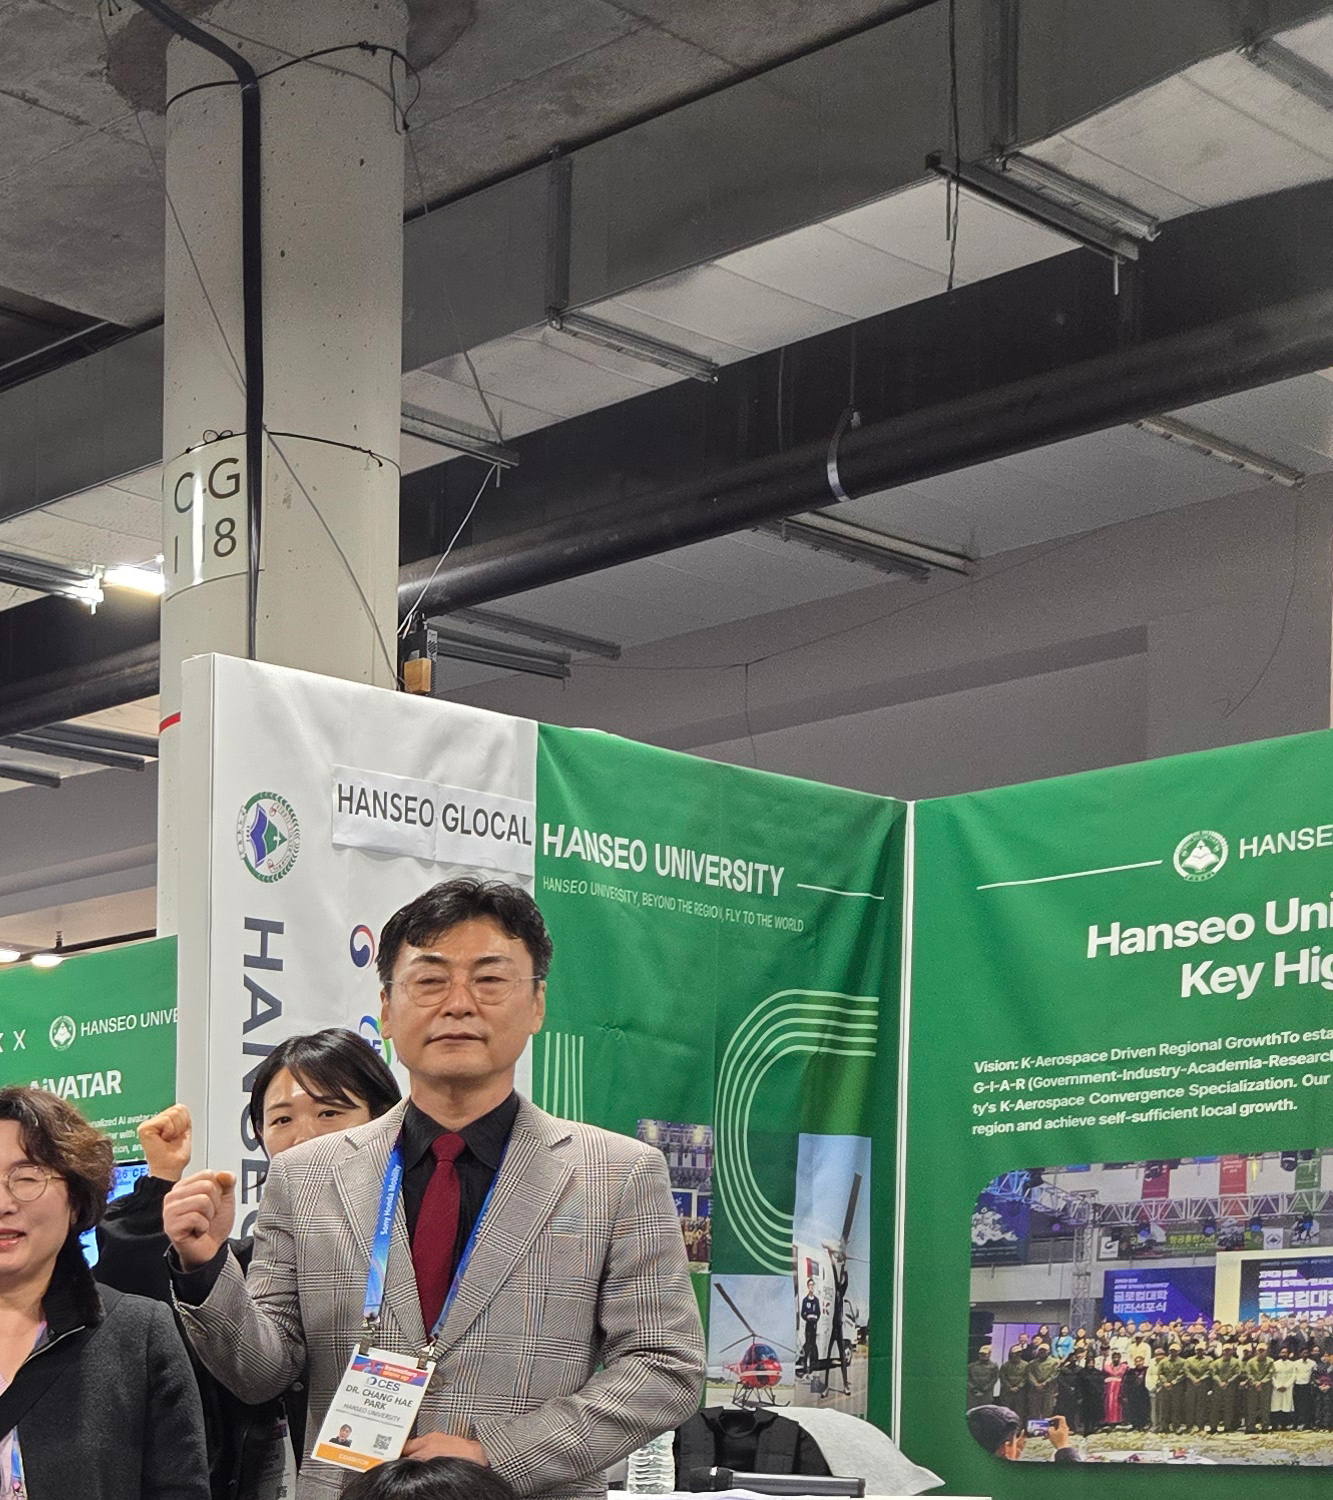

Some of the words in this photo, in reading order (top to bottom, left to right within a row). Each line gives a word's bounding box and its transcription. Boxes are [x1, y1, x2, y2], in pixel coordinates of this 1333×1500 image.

[337, 783, 435, 828] HANSEO
[441, 801, 533, 847] GLOCAL
[543, 823, 648, 873] HANSEO
[654, 843, 785, 897] UNIVERSITY
[542, 875, 588, 895] HANSEO
[589, 883, 641, 908] UNIVERSITY,
[642, 891, 676, 911] BEYOND
[677, 898, 694, 914] THE
[725, 909, 741, 925] FLY
[742, 910, 755, 925] TO
[756, 912, 773, 929] THE
[773, 916, 805, 933] WORLD
[1086, 912, 1256, 960] Hanseo
[1180, 959, 1265, 1000] Key
[12, 1029, 26, 1051] X
[80, 1013, 137, 1037] HANSEO
[973, 1059, 1019, 1074] Vision:
[1021, 1051, 1108, 1068] K-Aerospace
[1110, 1045, 1156, 1061] Driven
[1159, 1038, 1222, 1056] Regional
[972, 1102, 997, 1117] ty's
[999, 1095, 1085, 1112] K-Aerospace
[1088, 1086, 1185, 1106] Convergence
[1188, 1077, 1298, 1098] Specialization.
[1301, 1073, 1331, 1087] Our
[973, 1078, 1026, 1094] G-I-A-R
[972, 1120, 1015, 1137] region
[1016, 1118, 1042, 1132] and
[1044, 1115, 1096, 1130] achieve
[1098, 1105, 1199, 1126] self-sufficient
[1201, 1102, 1237, 1118] local
[1239, 1098, 1299, 1117] growth.
[384, 1192, 395, 1215] Honda
[380, 1214, 392, 1235] Sony
[345, 1384, 360, 1395] DR.
[362, 1388, 394, 1403] CHANG
[394, 1397, 413, 1408] HAE
[377, 1378, 401, 1392] CES
[364, 1398, 388, 1410] PARK
